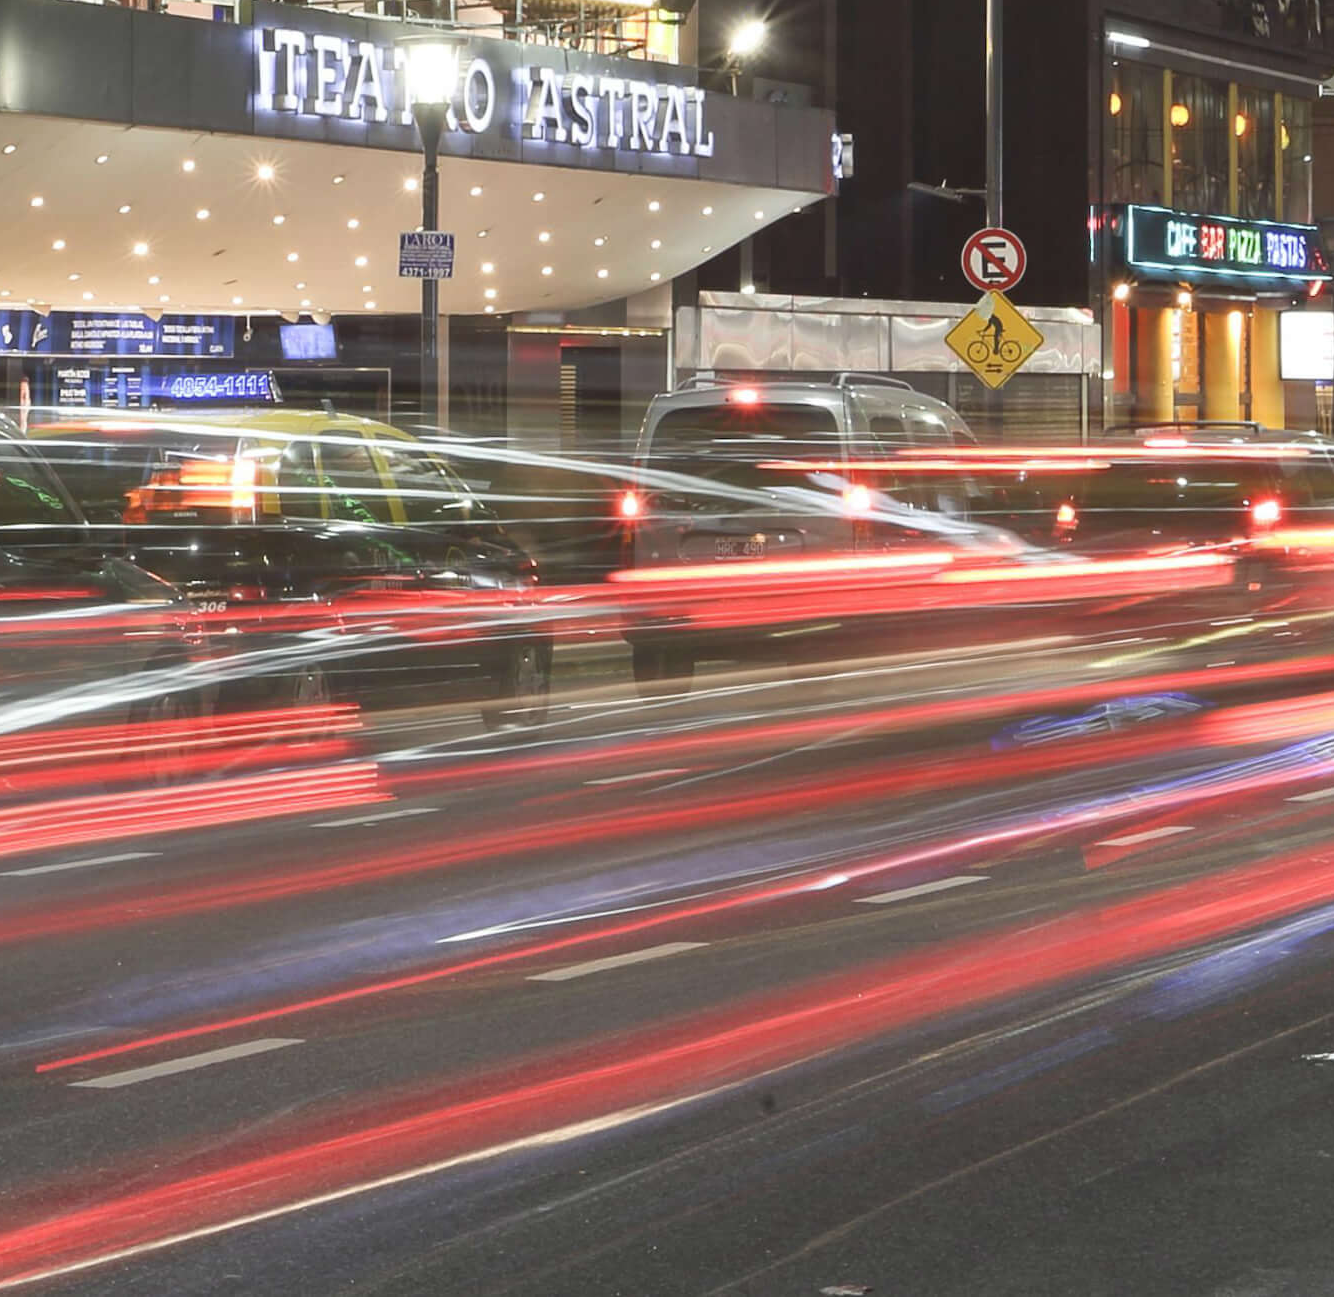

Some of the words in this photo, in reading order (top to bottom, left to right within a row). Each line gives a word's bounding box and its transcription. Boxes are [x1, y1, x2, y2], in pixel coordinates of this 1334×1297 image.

[523, 65, 715, 158] ASTRAL
[404, 233, 451, 247] TAROT
[1200, 223, 1226, 261] BAR
[1228, 228, 1263, 264] PIZZA
[1265, 232, 1307, 269] PASTAS
